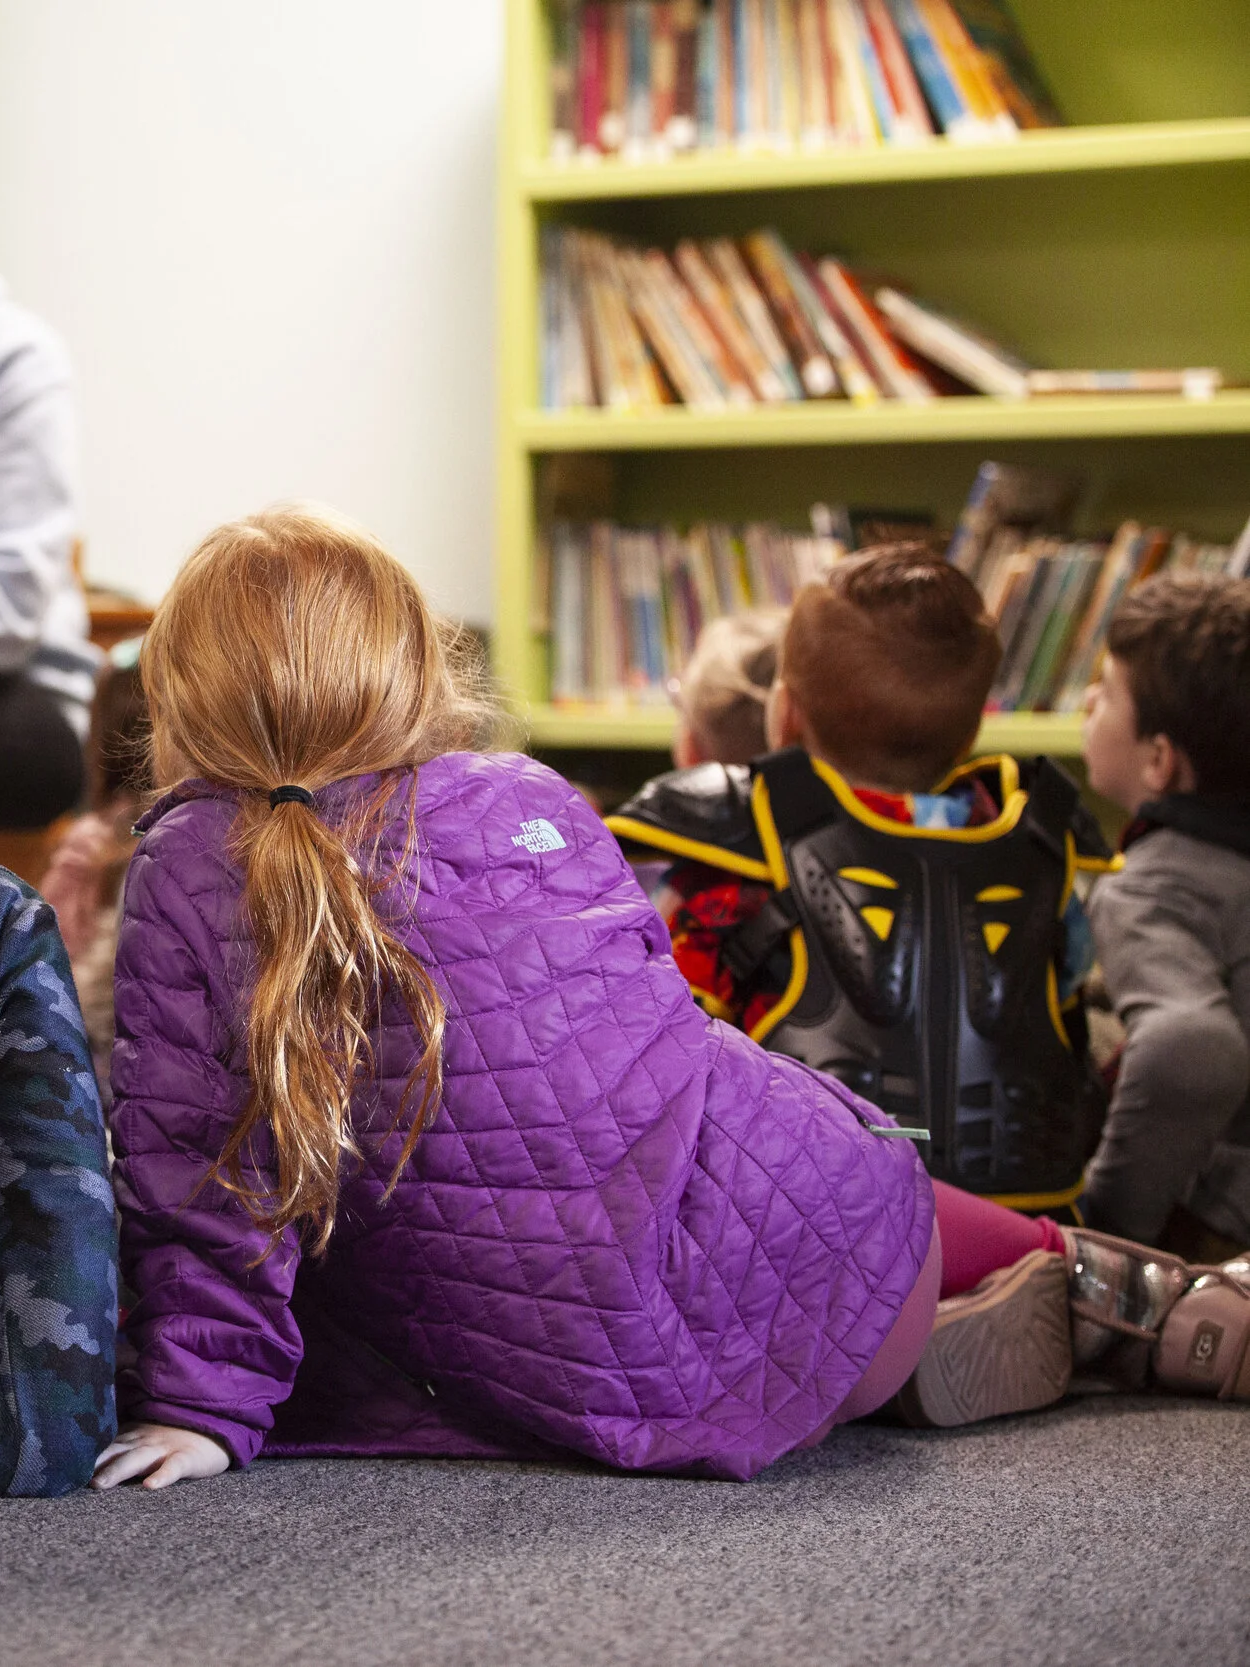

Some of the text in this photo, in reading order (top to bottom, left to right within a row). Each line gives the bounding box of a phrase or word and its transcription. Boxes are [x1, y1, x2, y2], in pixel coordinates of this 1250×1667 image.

[519, 820, 540, 834] THE
[511, 831, 544, 847] NORTH
[526, 841, 552, 854] FACE
